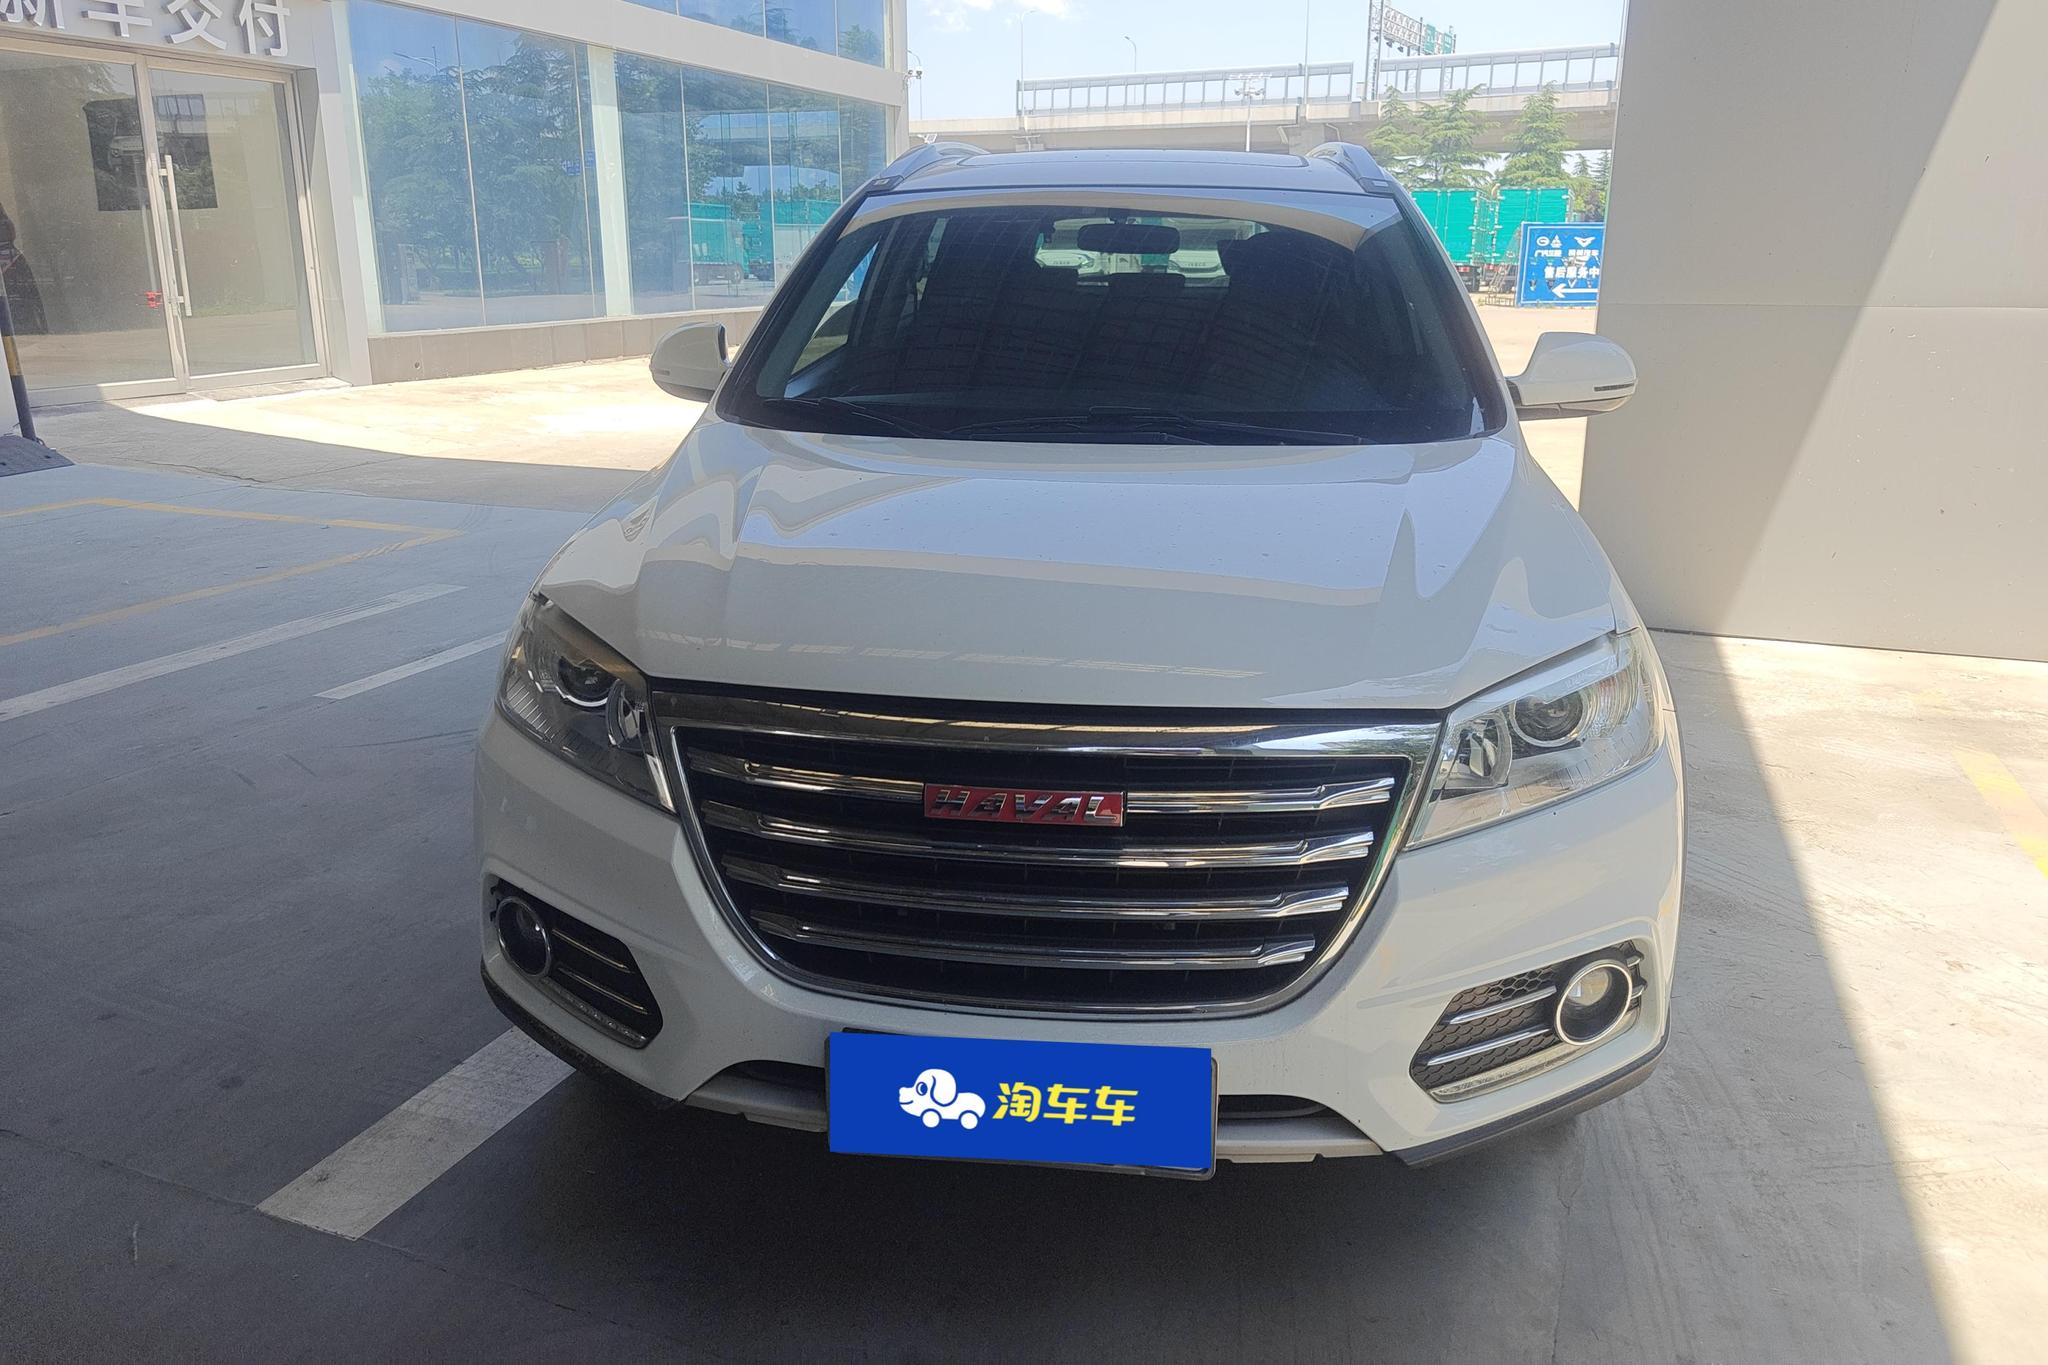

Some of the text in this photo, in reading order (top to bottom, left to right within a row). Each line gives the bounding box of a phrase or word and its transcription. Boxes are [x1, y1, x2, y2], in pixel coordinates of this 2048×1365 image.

[1544, 265, 1600, 279] 售后服务中
[931, 789, 1118, 824] HAVAL
